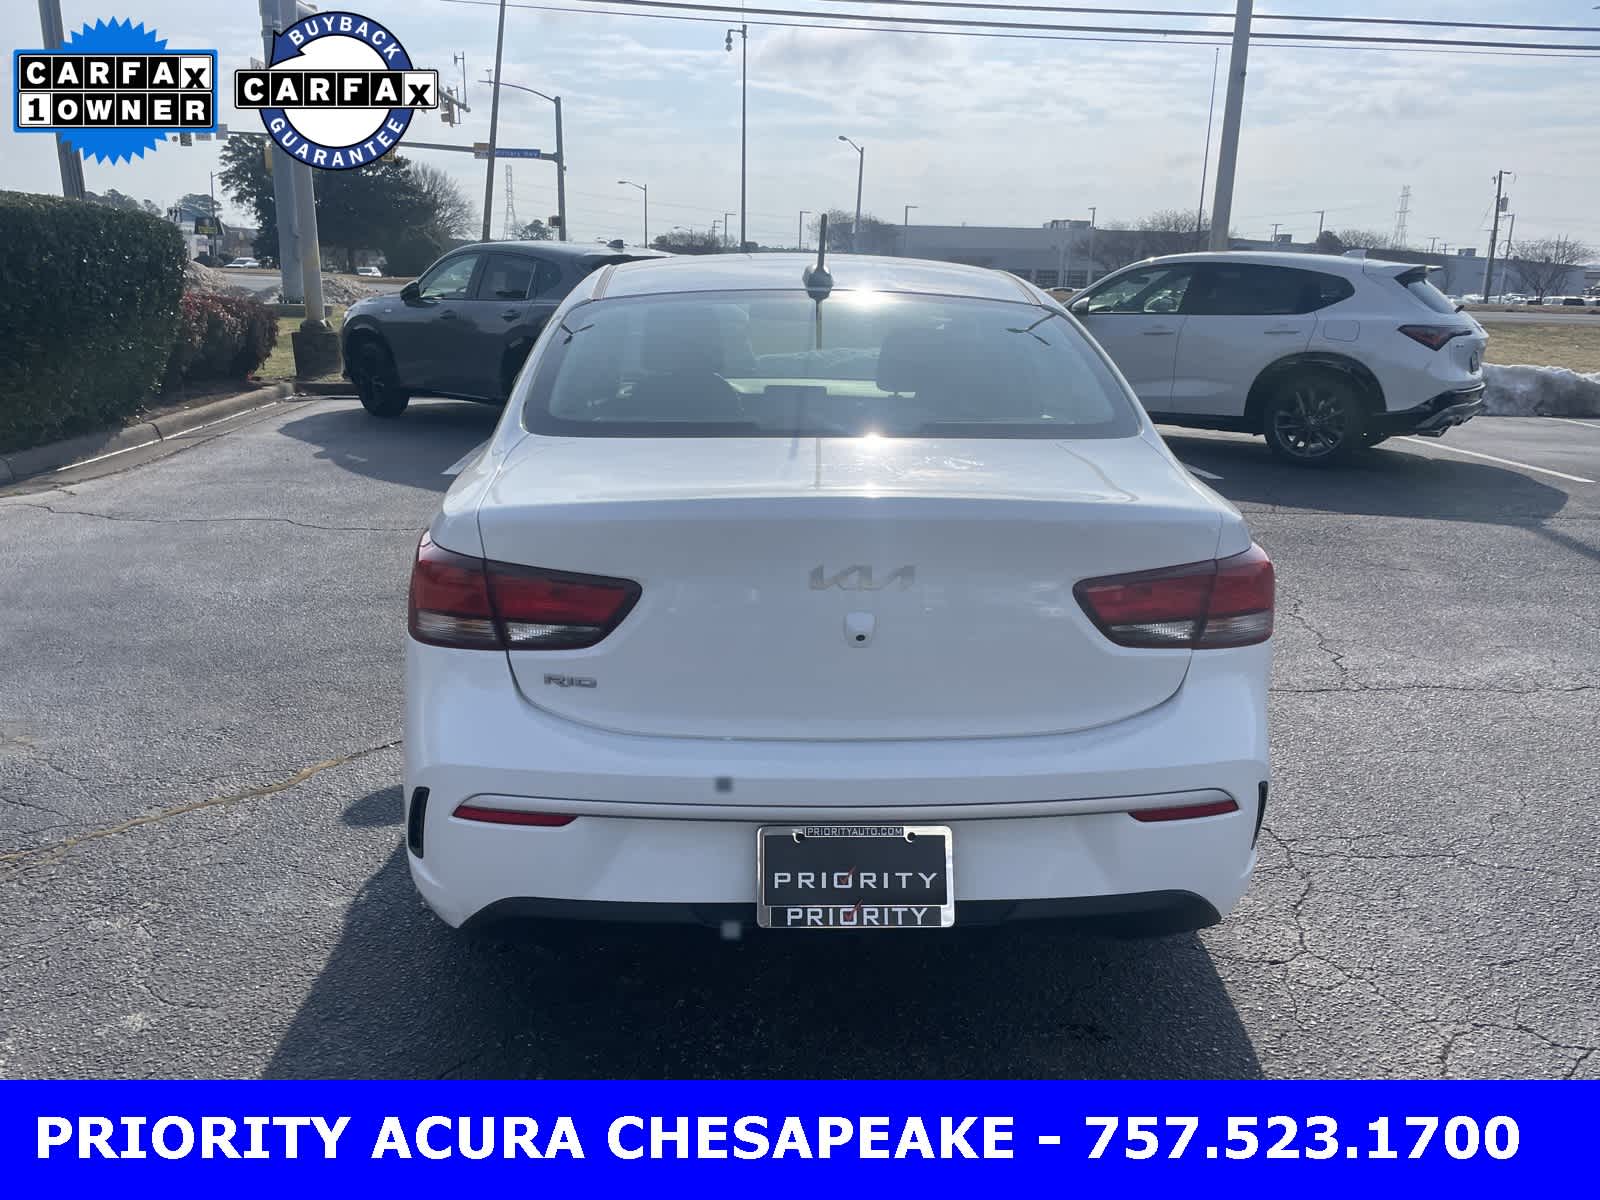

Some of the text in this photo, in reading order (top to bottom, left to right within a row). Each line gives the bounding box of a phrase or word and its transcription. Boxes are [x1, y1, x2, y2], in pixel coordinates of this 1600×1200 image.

[544, 673, 598, 688] RIO
[806, 827, 903, 836] PRIORITYAUTO.COM
[774, 872, 938, 889] PRIORITY
[787, 907, 928, 926] PRIORITY
